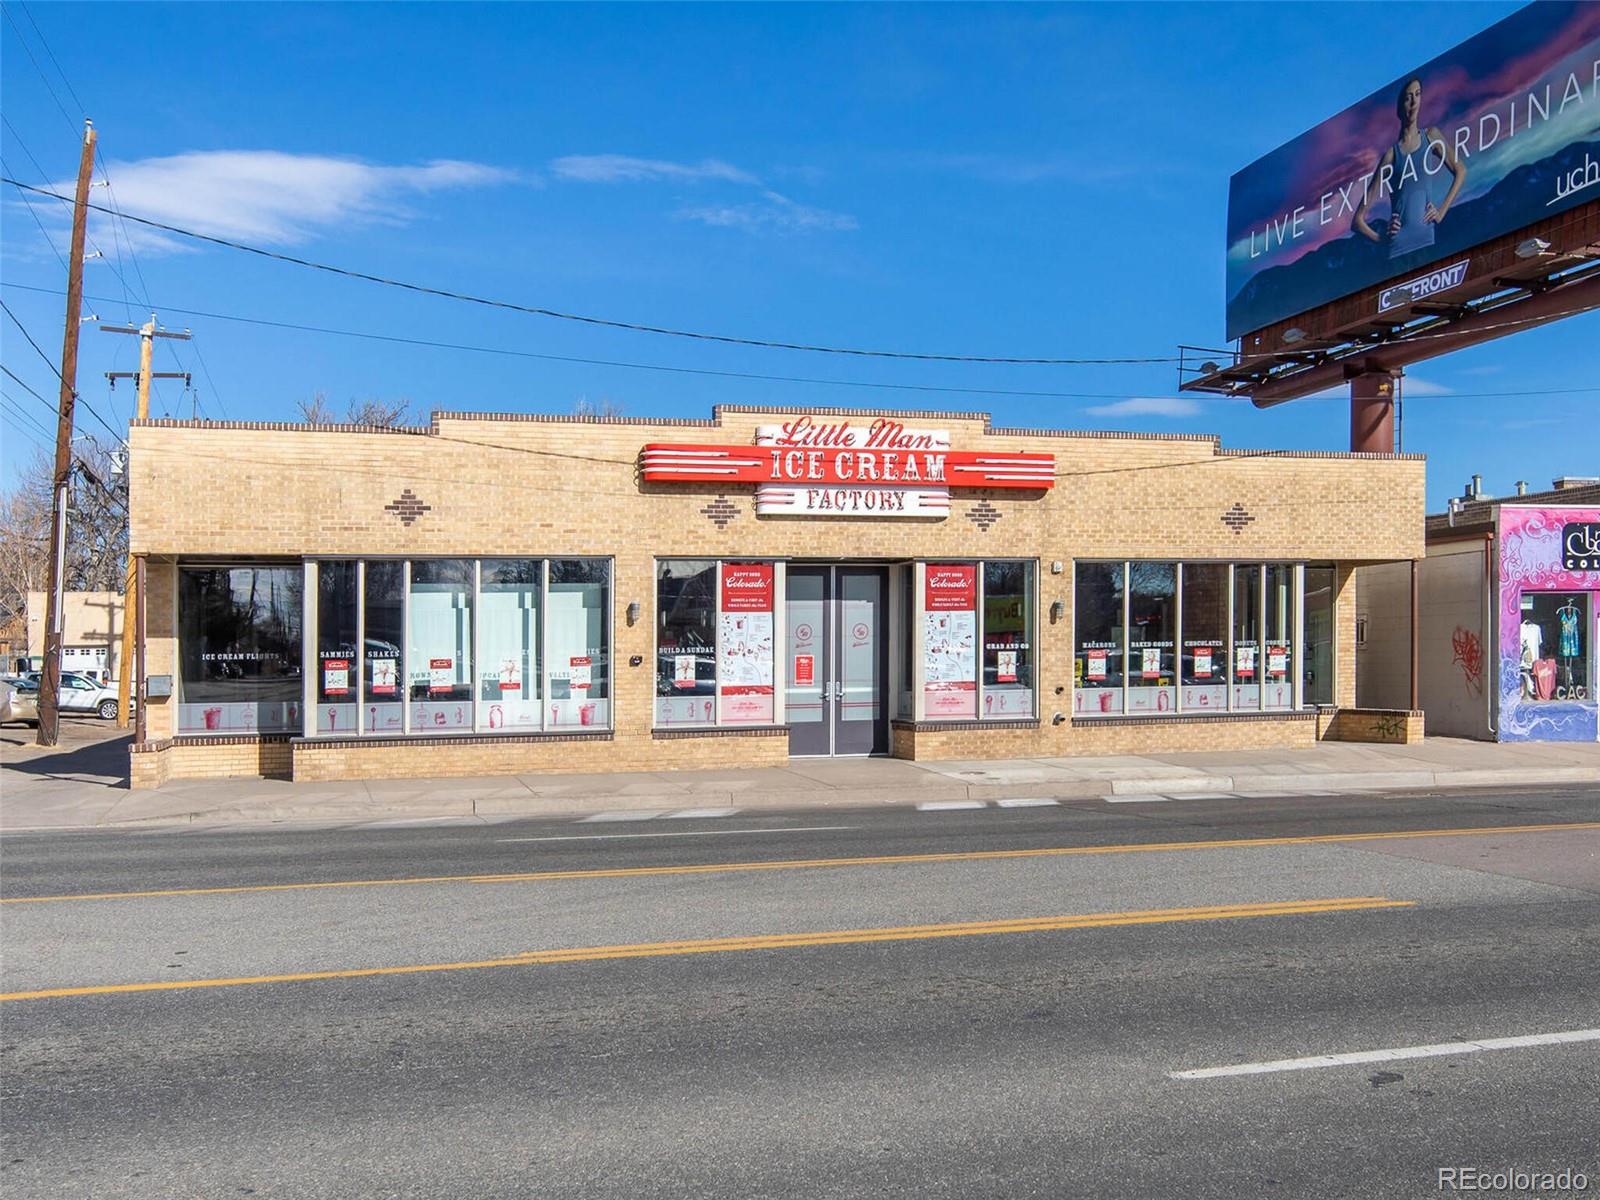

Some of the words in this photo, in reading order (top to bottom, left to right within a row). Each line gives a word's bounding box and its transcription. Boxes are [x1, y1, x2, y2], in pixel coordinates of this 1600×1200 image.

[1250, 205, 1305, 259] LIVE
[776, 415, 857, 449] Little
[864, 418, 935, 449] Man
[770, 450, 825, 479] ICE
[834, 451, 947, 482] CREAM
[805, 488, 907, 511] FACTORY
[320, 651, 355, 659] SAMMIES
[367, 650, 400, 658] SHAKES
